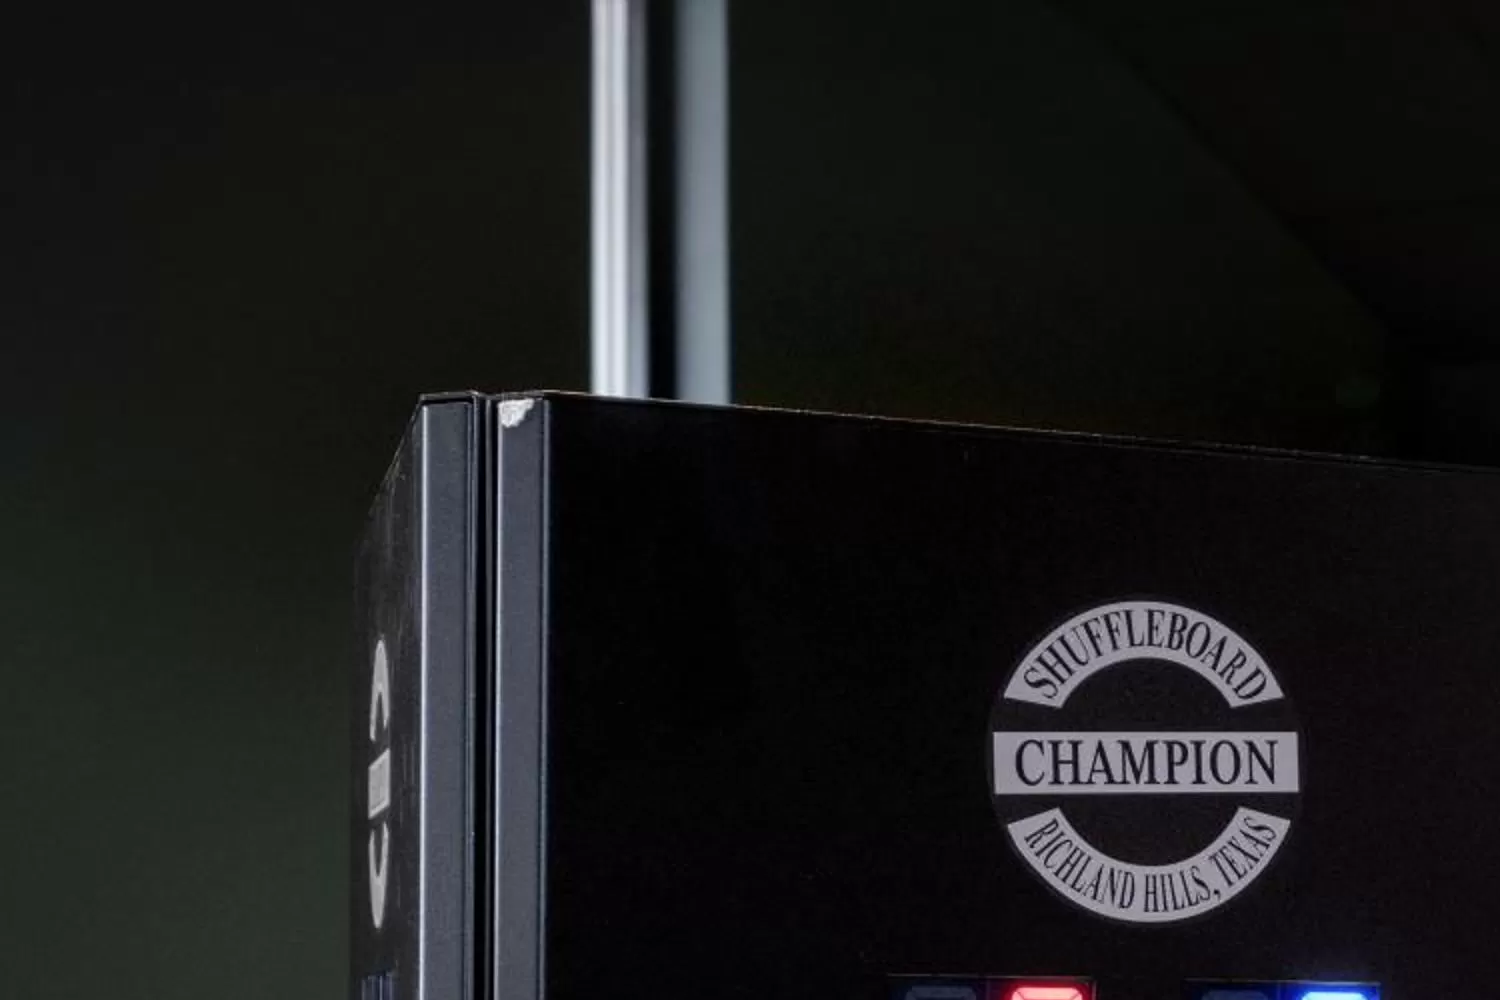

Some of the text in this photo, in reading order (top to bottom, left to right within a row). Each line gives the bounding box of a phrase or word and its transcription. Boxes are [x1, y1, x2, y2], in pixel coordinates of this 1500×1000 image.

[1022, 608, 1267, 701] SHUFFLEBOARD
[1014, 738, 1279, 787] CHAMPION
[1023, 816, 1277, 914] RICHLAND HILLS, TEXAS
